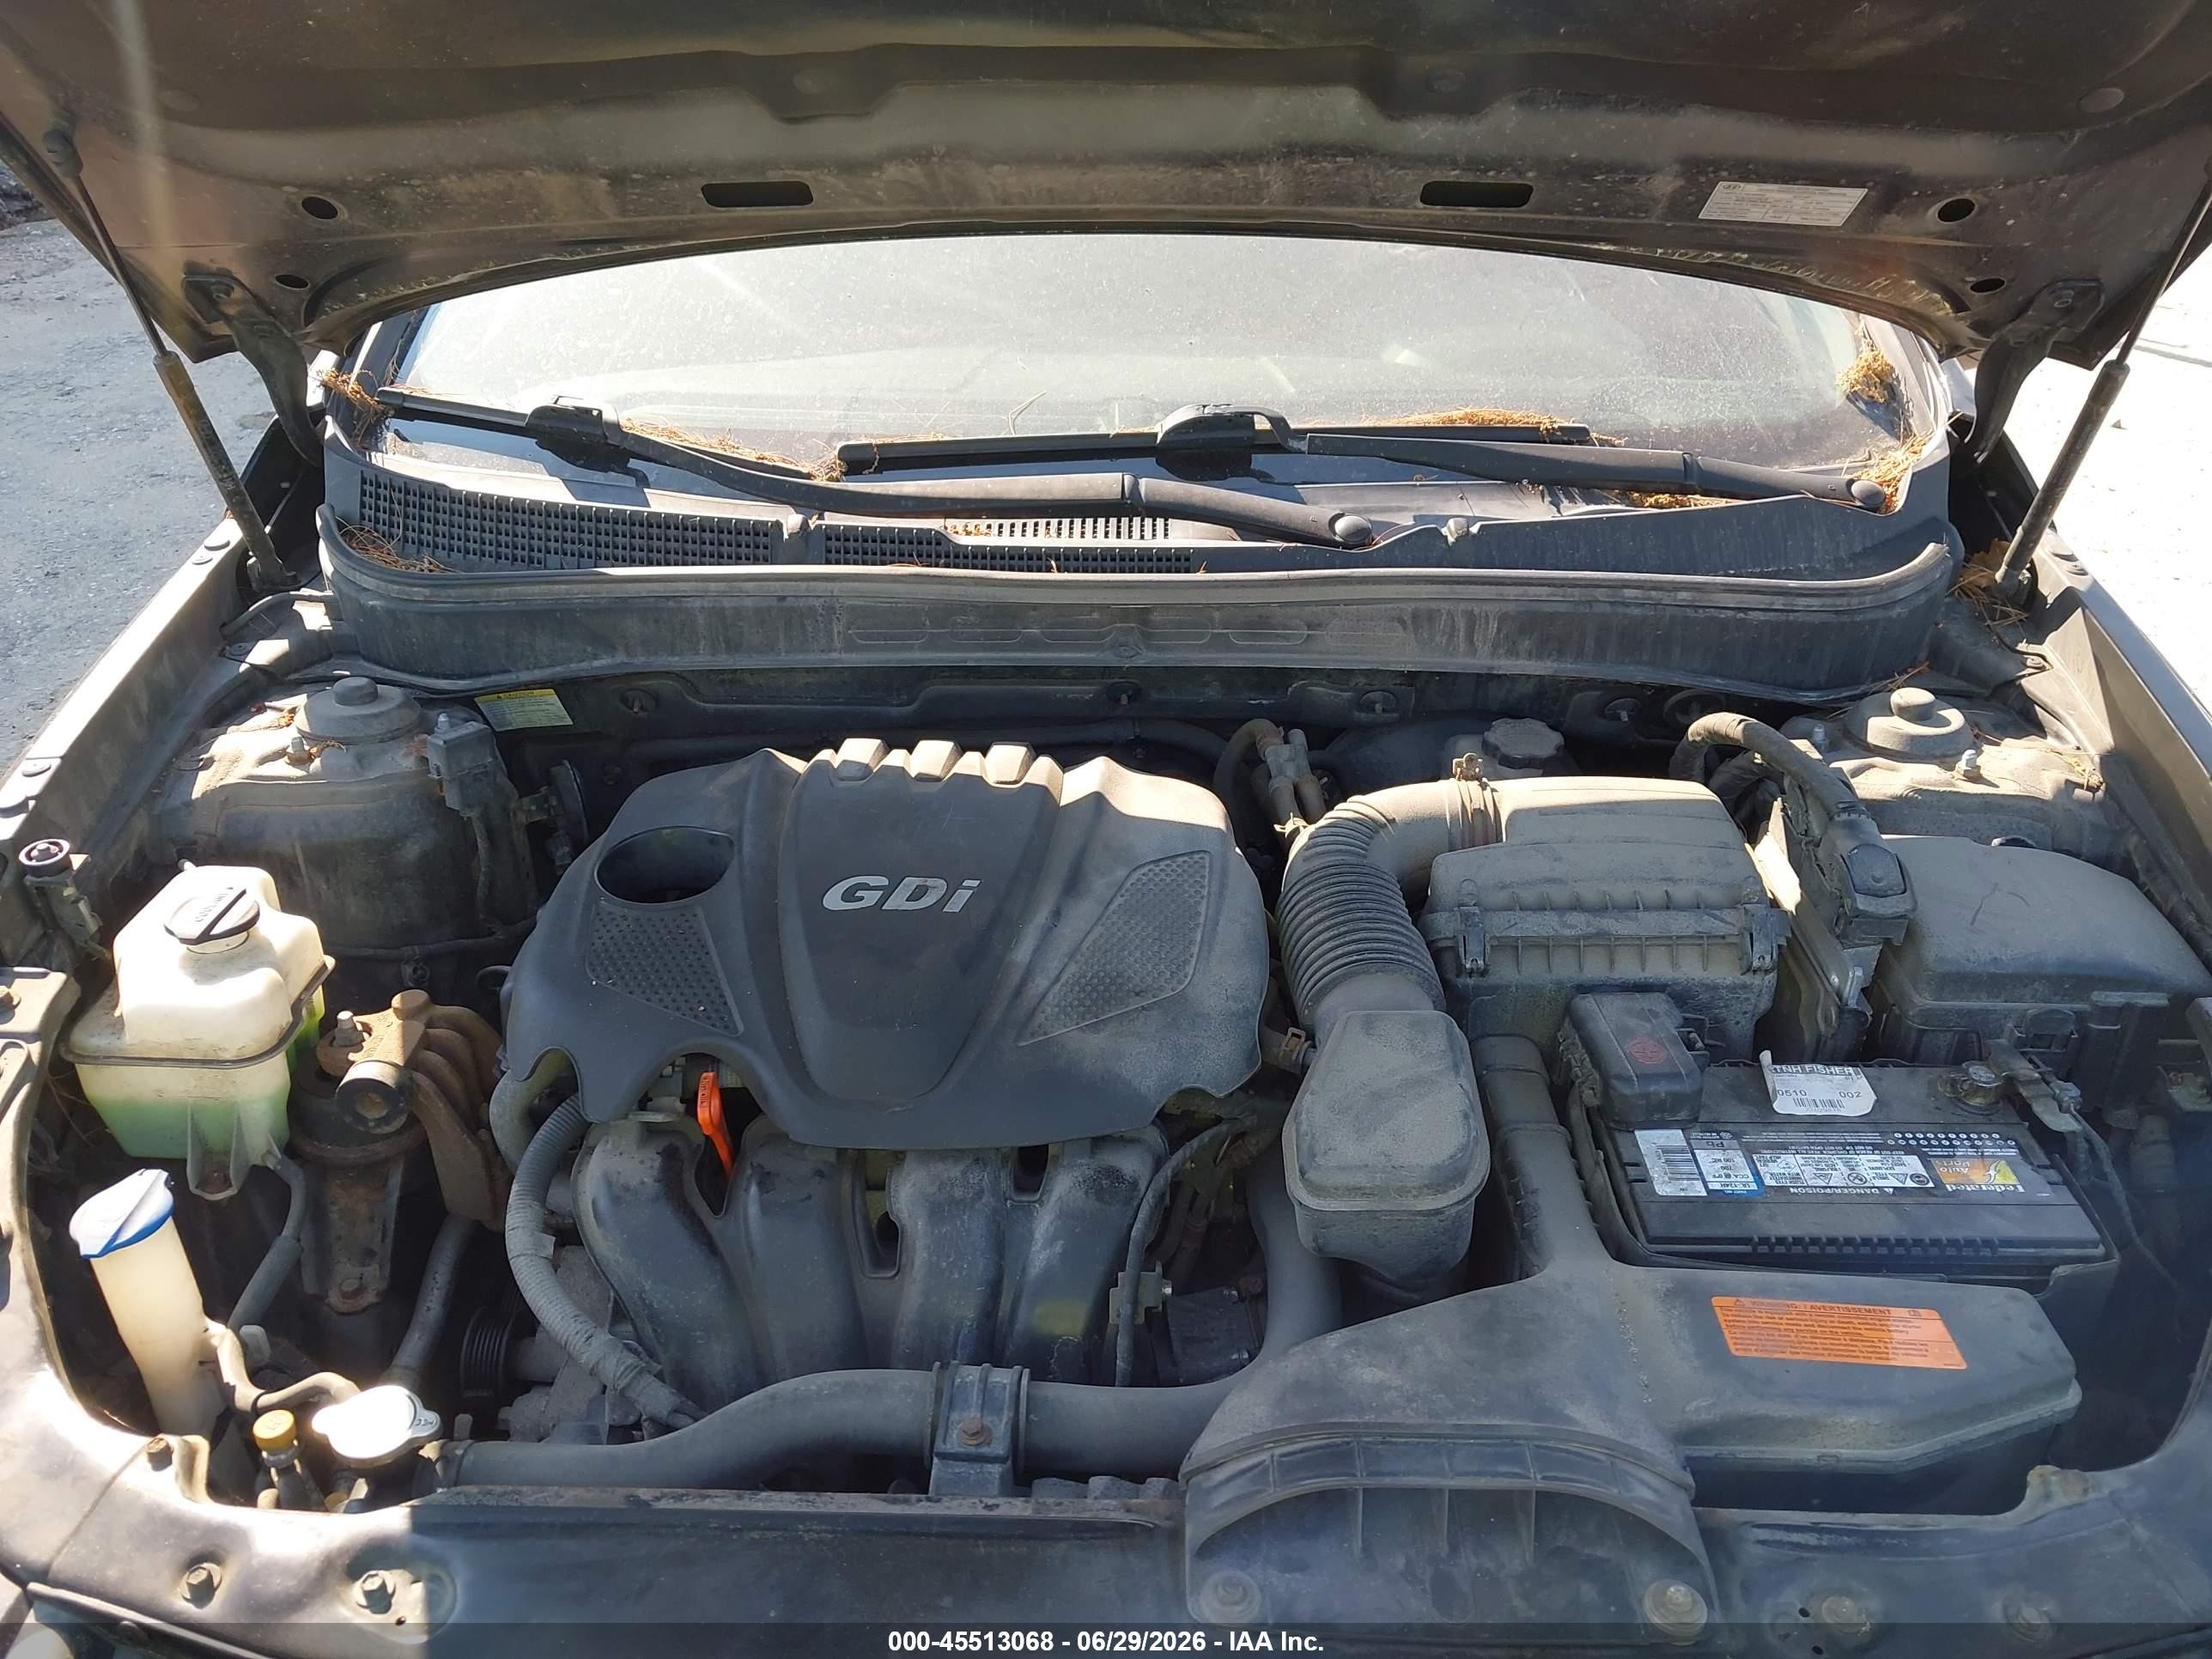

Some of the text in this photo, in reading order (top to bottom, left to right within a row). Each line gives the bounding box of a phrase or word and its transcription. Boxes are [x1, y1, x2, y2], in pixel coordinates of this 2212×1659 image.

[823, 875, 982, 913] GDi
[1945, 1184, 2027, 1193] Federated
[1810, 1304, 1891, 1316] AVERTISSEMENT
